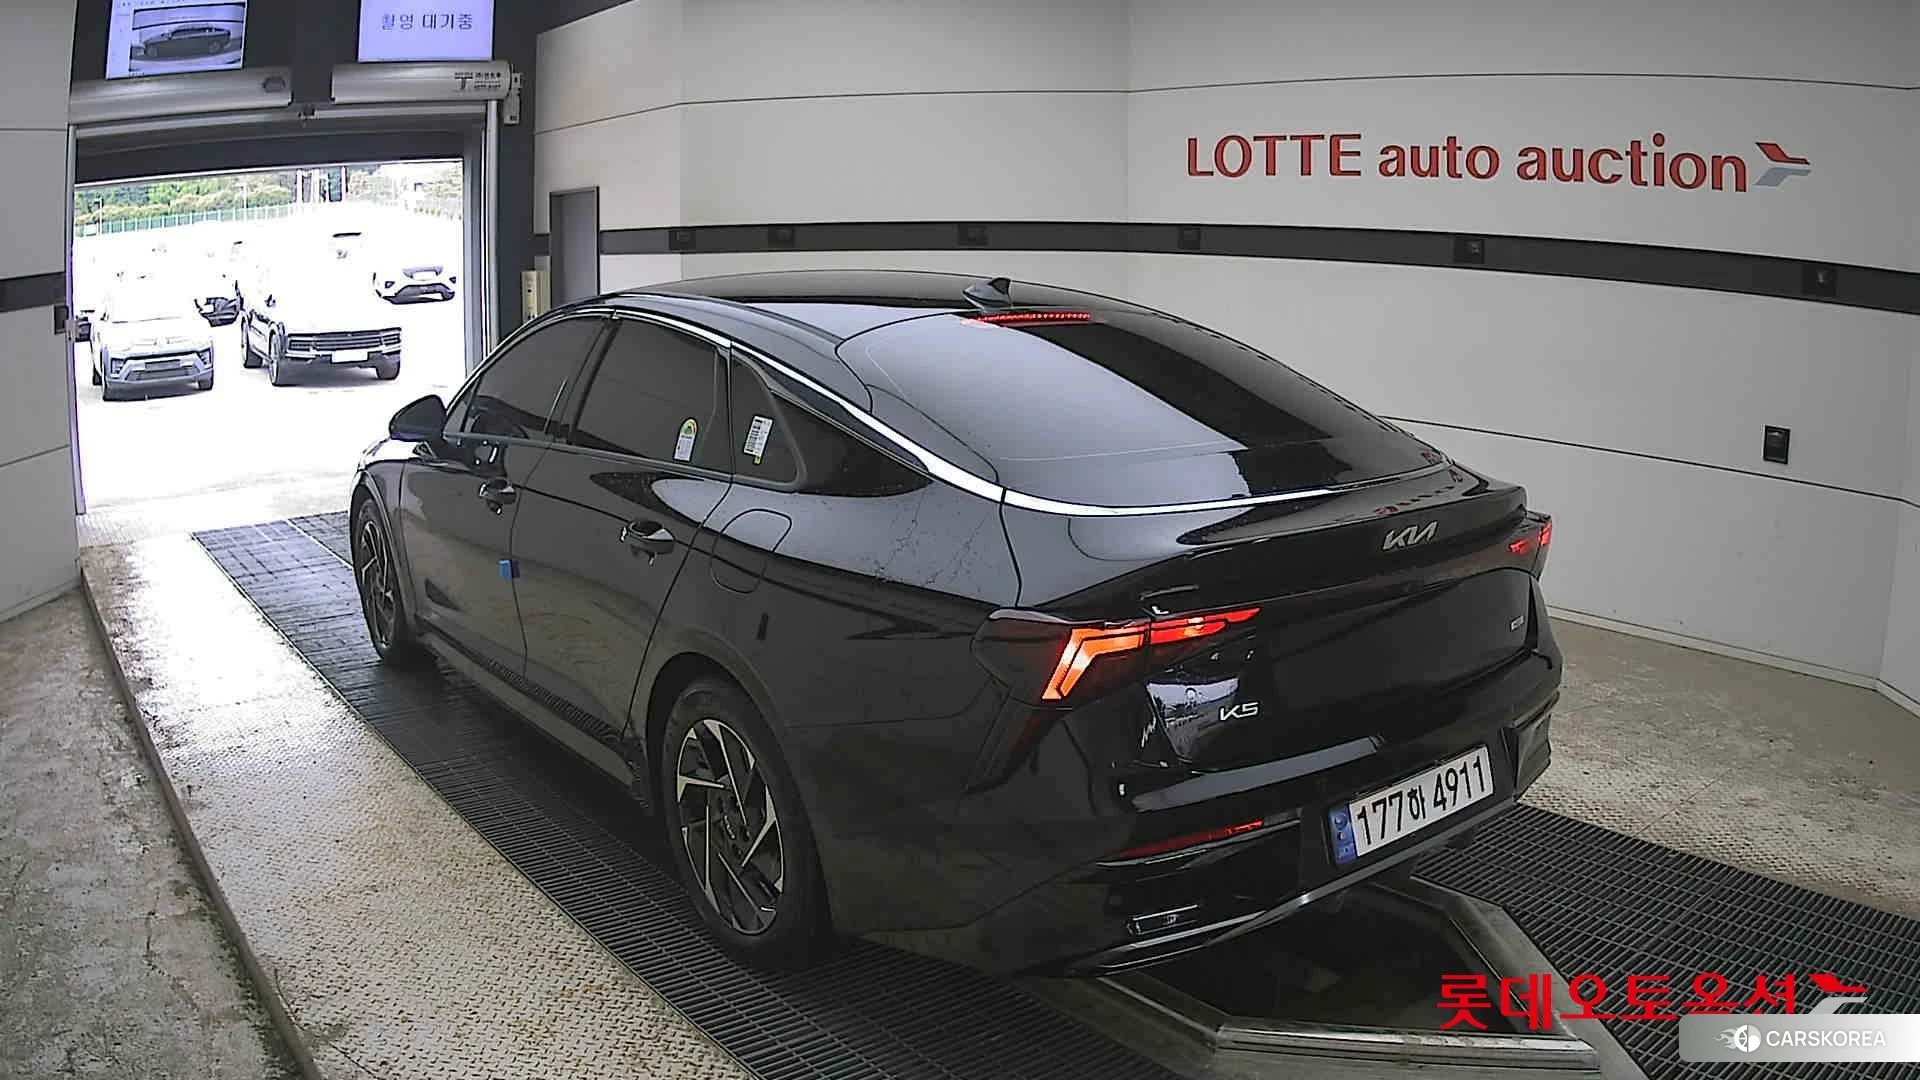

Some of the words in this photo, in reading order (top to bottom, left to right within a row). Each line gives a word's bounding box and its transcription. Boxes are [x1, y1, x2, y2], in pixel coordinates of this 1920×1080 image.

[422, 13, 472, 30] 대기중
[1187, 133, 1362, 178] LOTTE
[1378, 135, 1500, 180] auto
[1517, 132, 1747, 193] auction
[1383, 521, 1437, 550] KIA
[1220, 701, 1259, 721] K5
[1357, 784, 1426, 845] 177하
[1433, 755, 1485, 811] 4911
